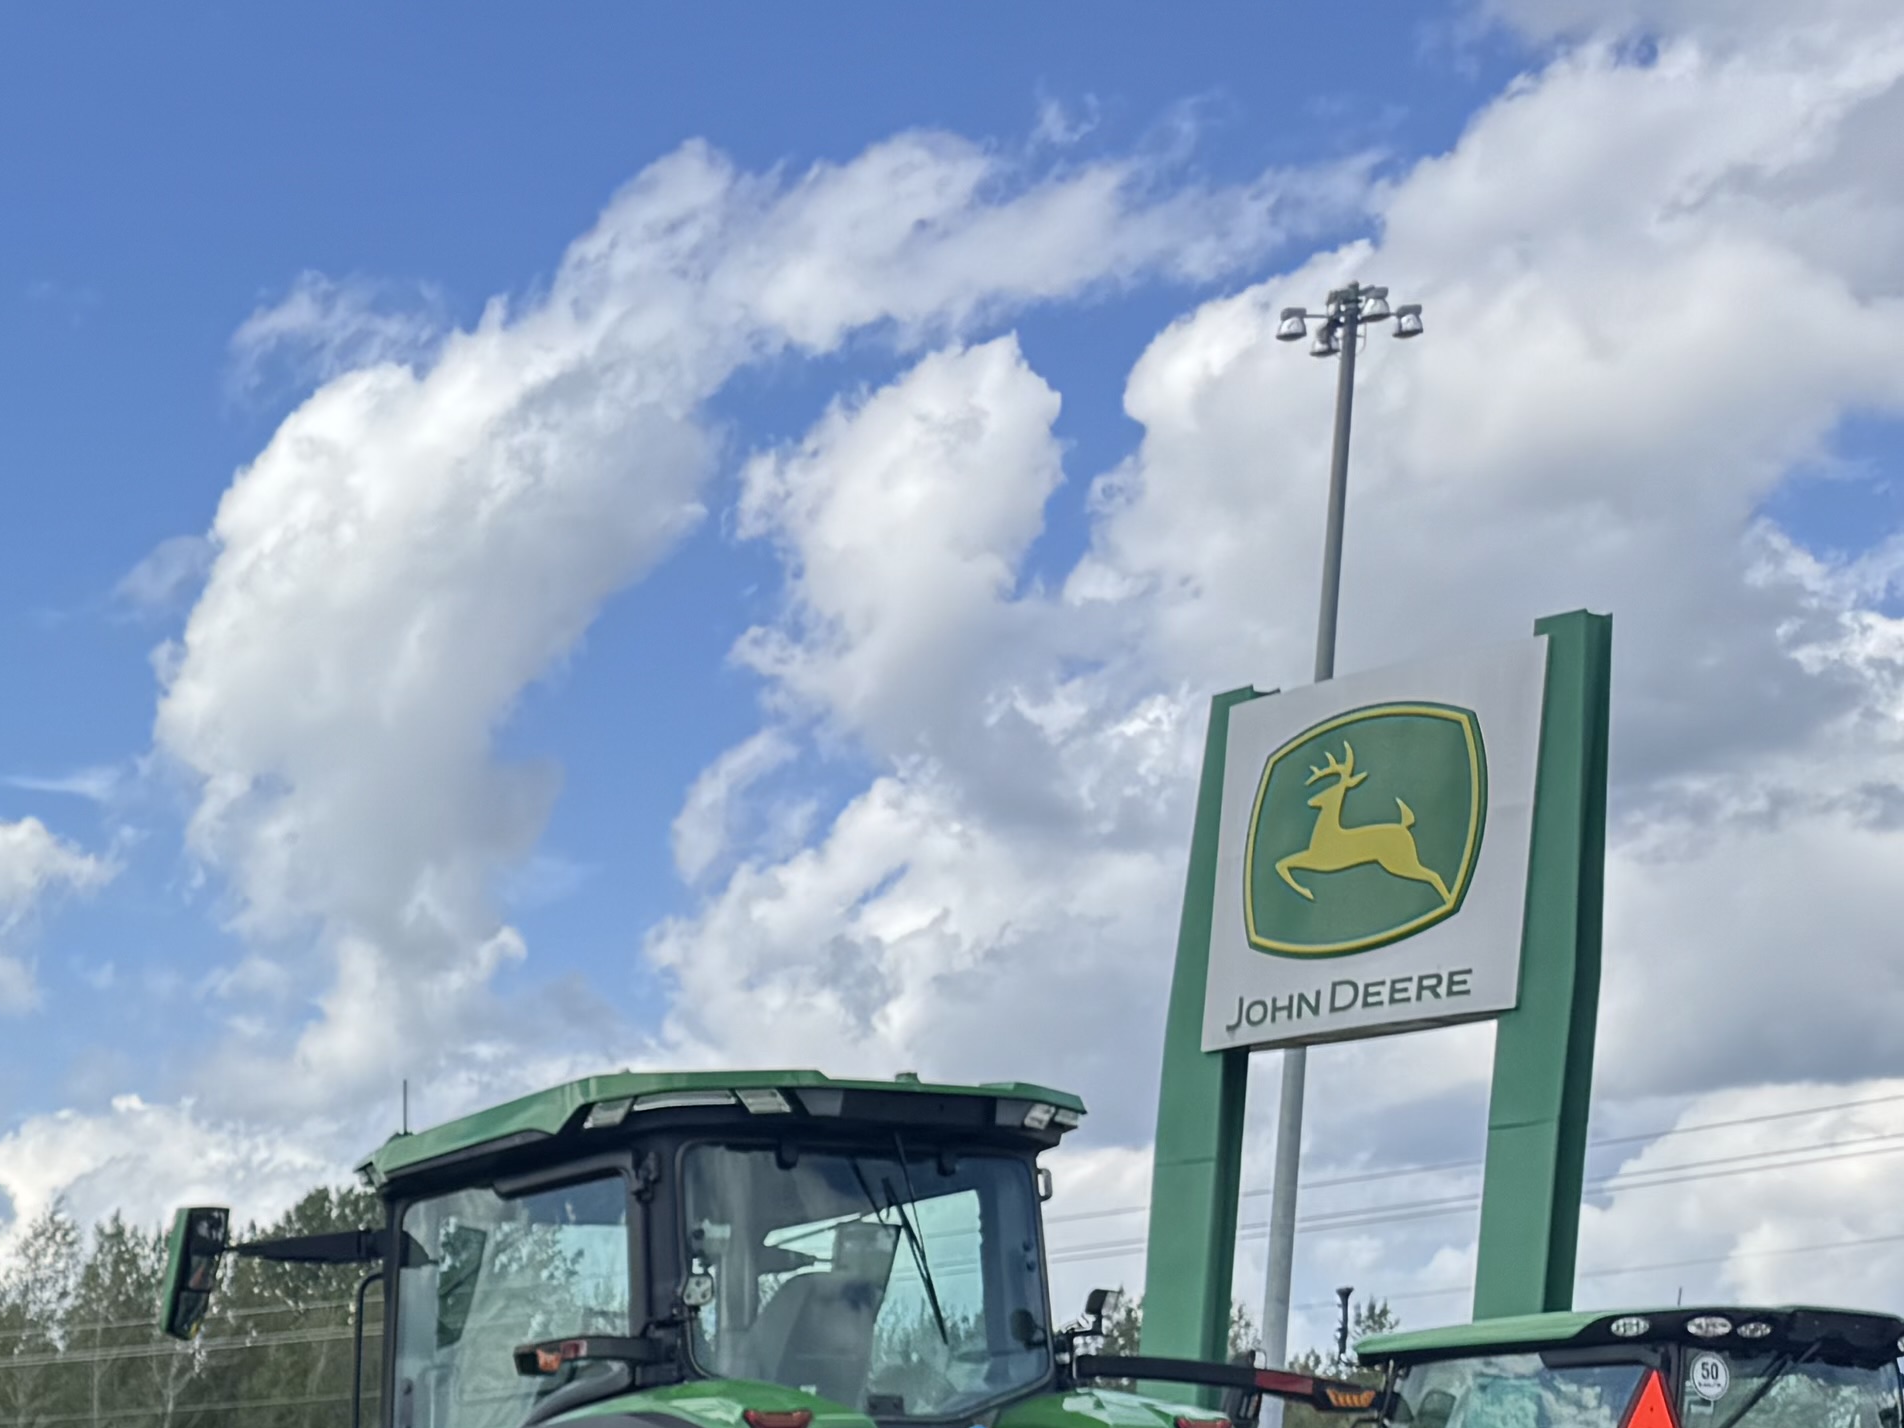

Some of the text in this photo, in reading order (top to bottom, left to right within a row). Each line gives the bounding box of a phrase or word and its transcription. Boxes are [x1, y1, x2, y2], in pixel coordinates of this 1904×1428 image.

[1225, 968, 1473, 1032] JOHN DEERE
[1700, 1361, 1719, 1380] 50
